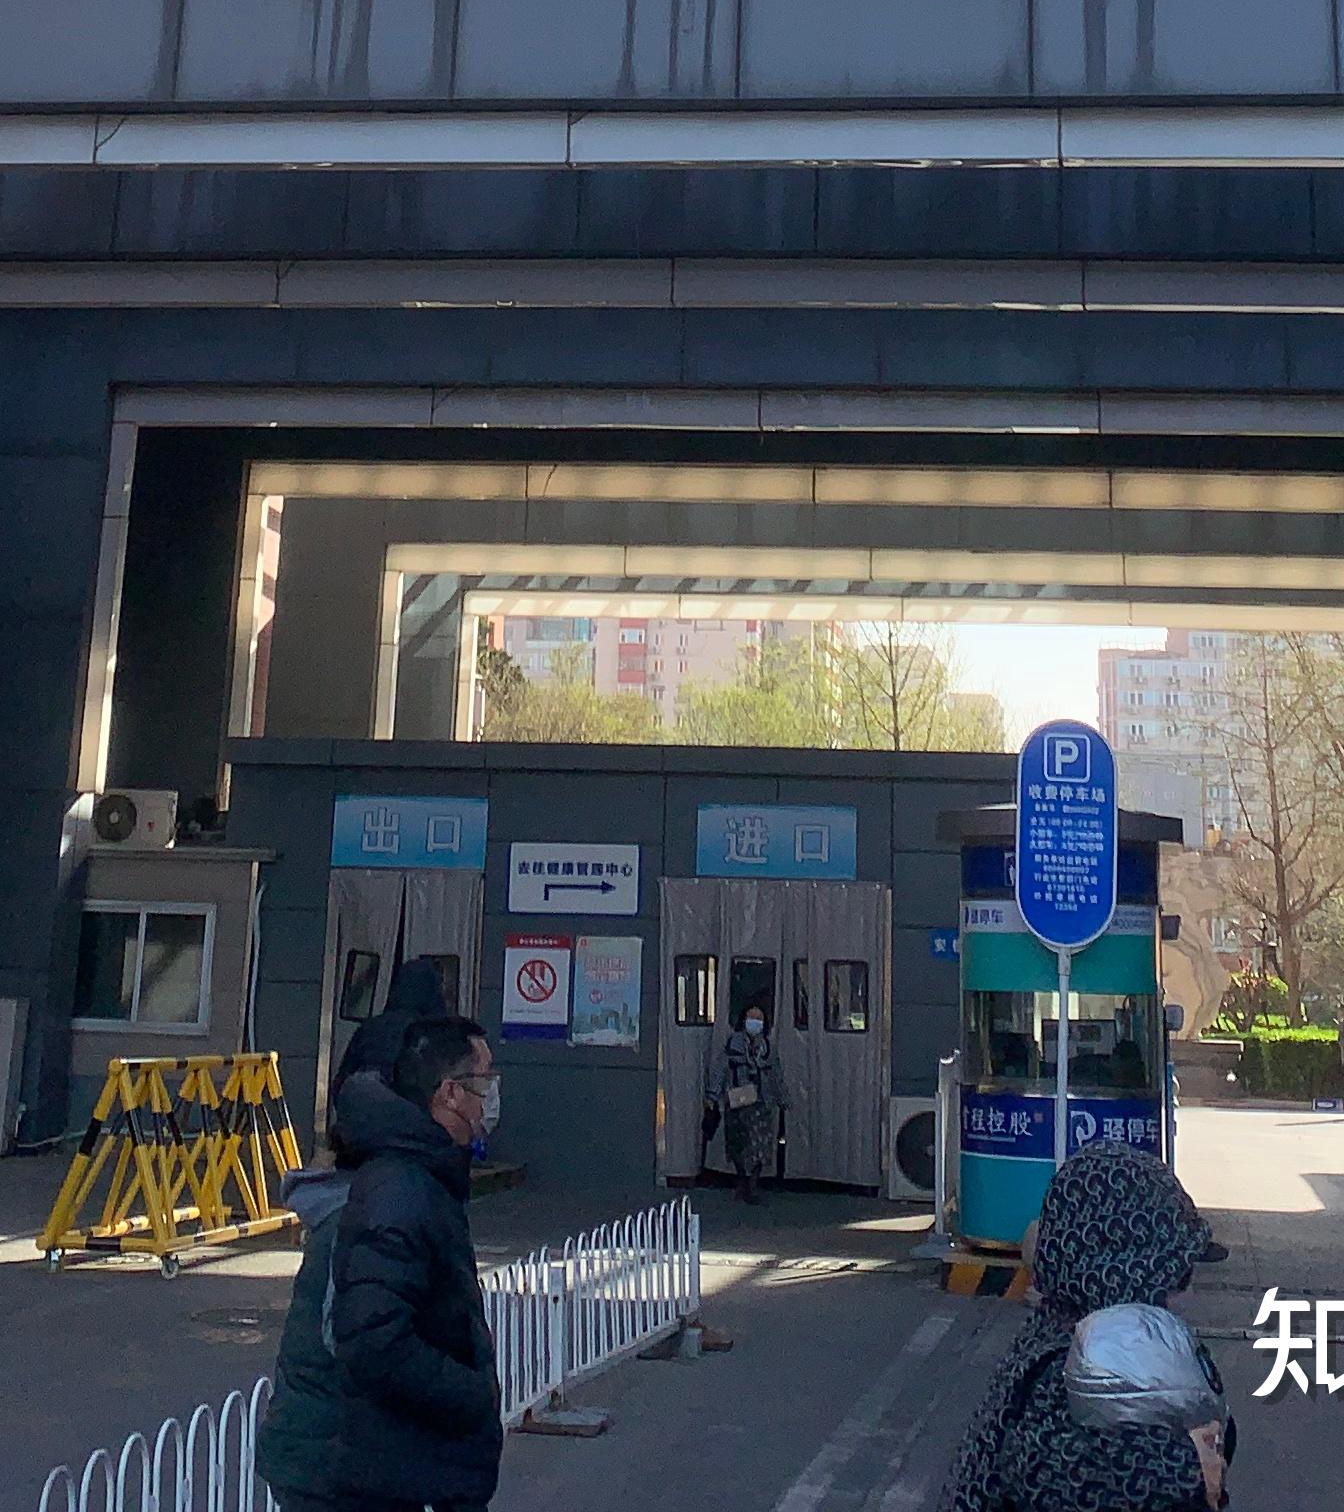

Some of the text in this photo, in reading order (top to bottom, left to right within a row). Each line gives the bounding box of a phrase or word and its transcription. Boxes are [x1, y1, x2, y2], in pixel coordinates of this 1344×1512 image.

[1054, 740, 1079, 775] P
[1028, 784, 1106, 803] 收费停车场
[360, 806, 463, 855] 出口
[724, 816, 831, 865] 进口
